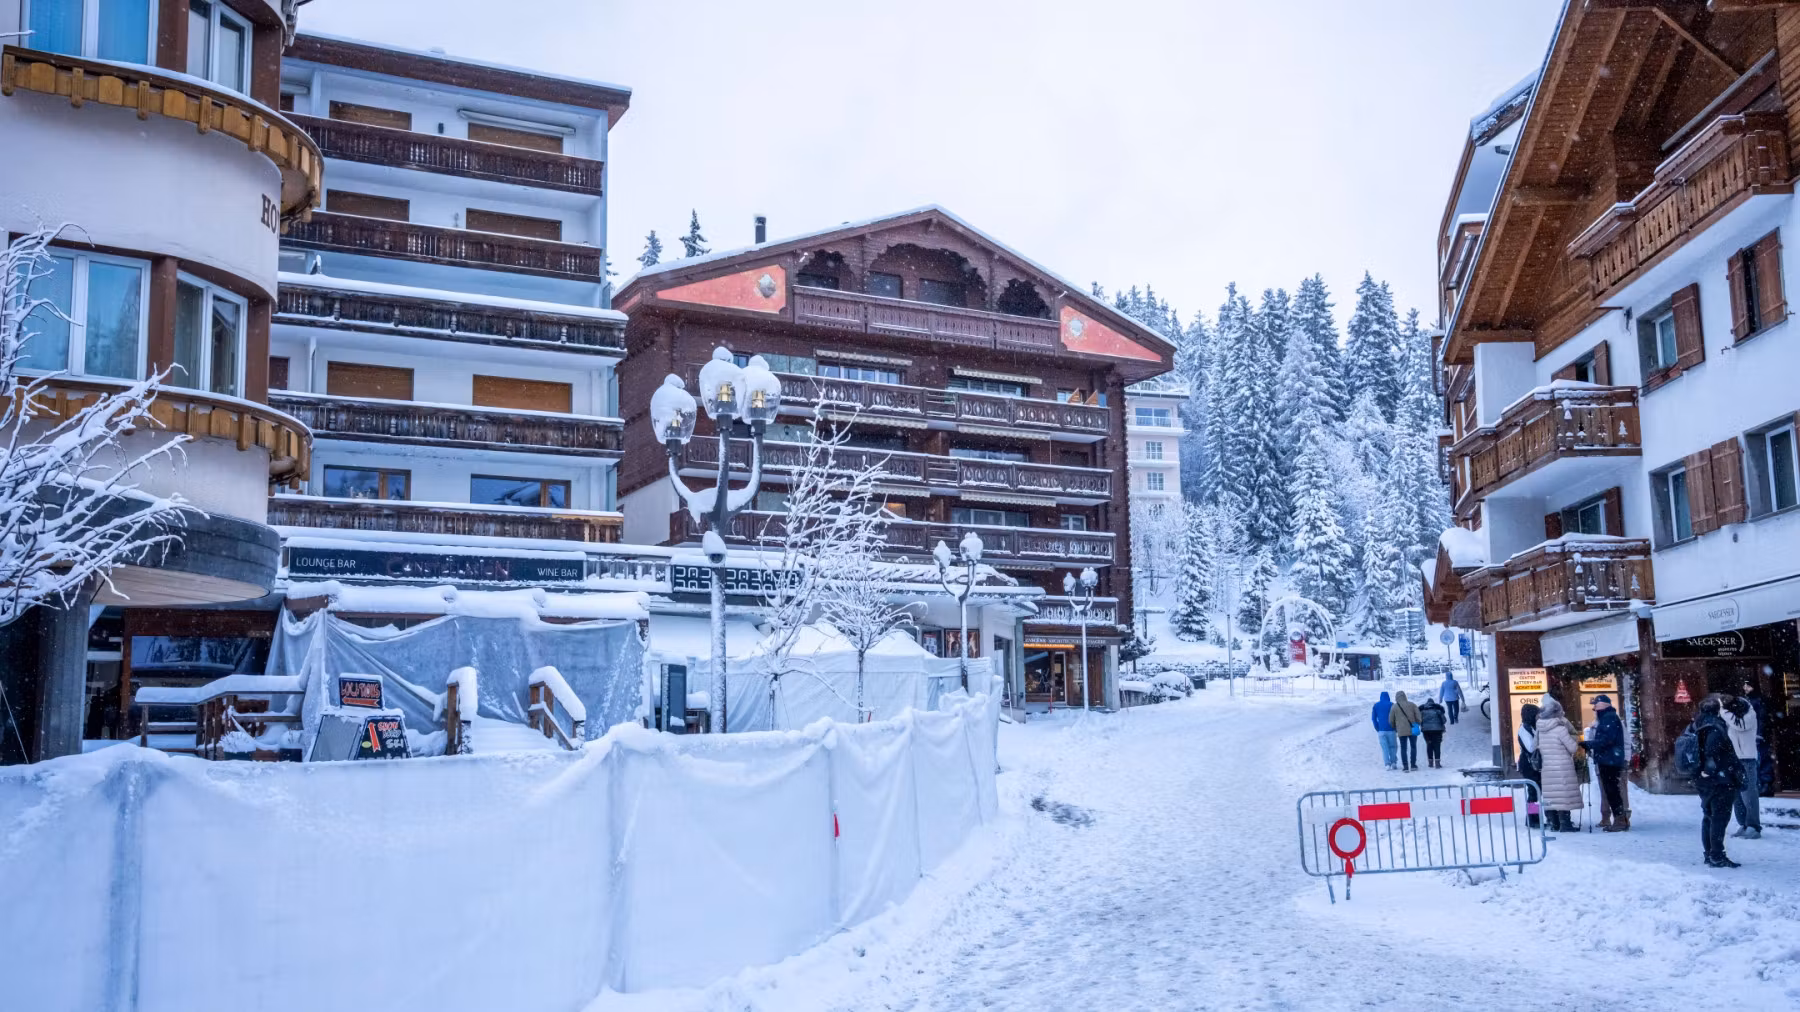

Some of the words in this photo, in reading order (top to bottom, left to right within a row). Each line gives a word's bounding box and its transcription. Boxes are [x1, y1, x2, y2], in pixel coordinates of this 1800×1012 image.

[261, 193, 280, 240] HO
[296, 557, 335, 568] LOUNGE
[337, 558, 356, 569] BAR
[537, 567, 559, 577] WINE
[561, 568, 578, 578] BAR
[1686, 636, 1737, 647] SAEGESSER
[1520, 697, 1539, 705] ORIS
[377, 721, 399, 731] SNOW
[386, 738, 404, 748] SKI
